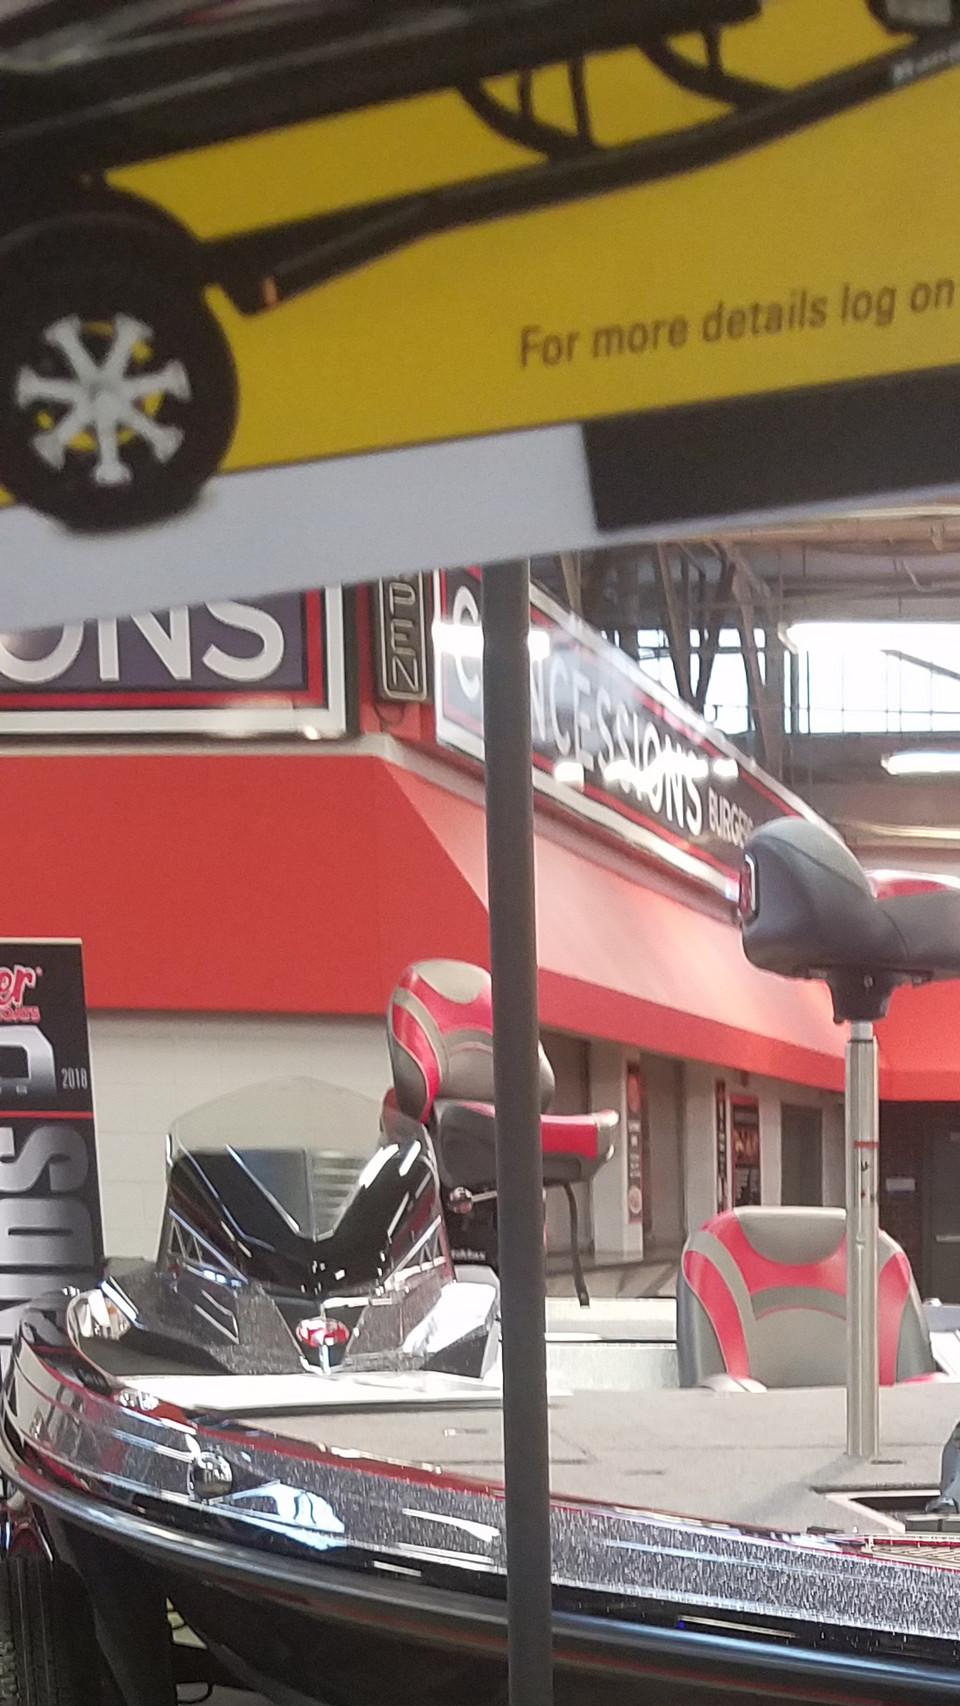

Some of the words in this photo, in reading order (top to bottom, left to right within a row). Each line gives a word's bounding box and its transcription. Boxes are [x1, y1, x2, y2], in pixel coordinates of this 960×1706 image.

[519, 324, 581, 369] For
[591, 313, 689, 359] more
[701, 290, 828, 343] details
[840, 283, 897, 327] log
[909, 276, 955, 314] on
[389, 573, 419, 692] PEN
[61, 1067, 88, 1090] 2018
